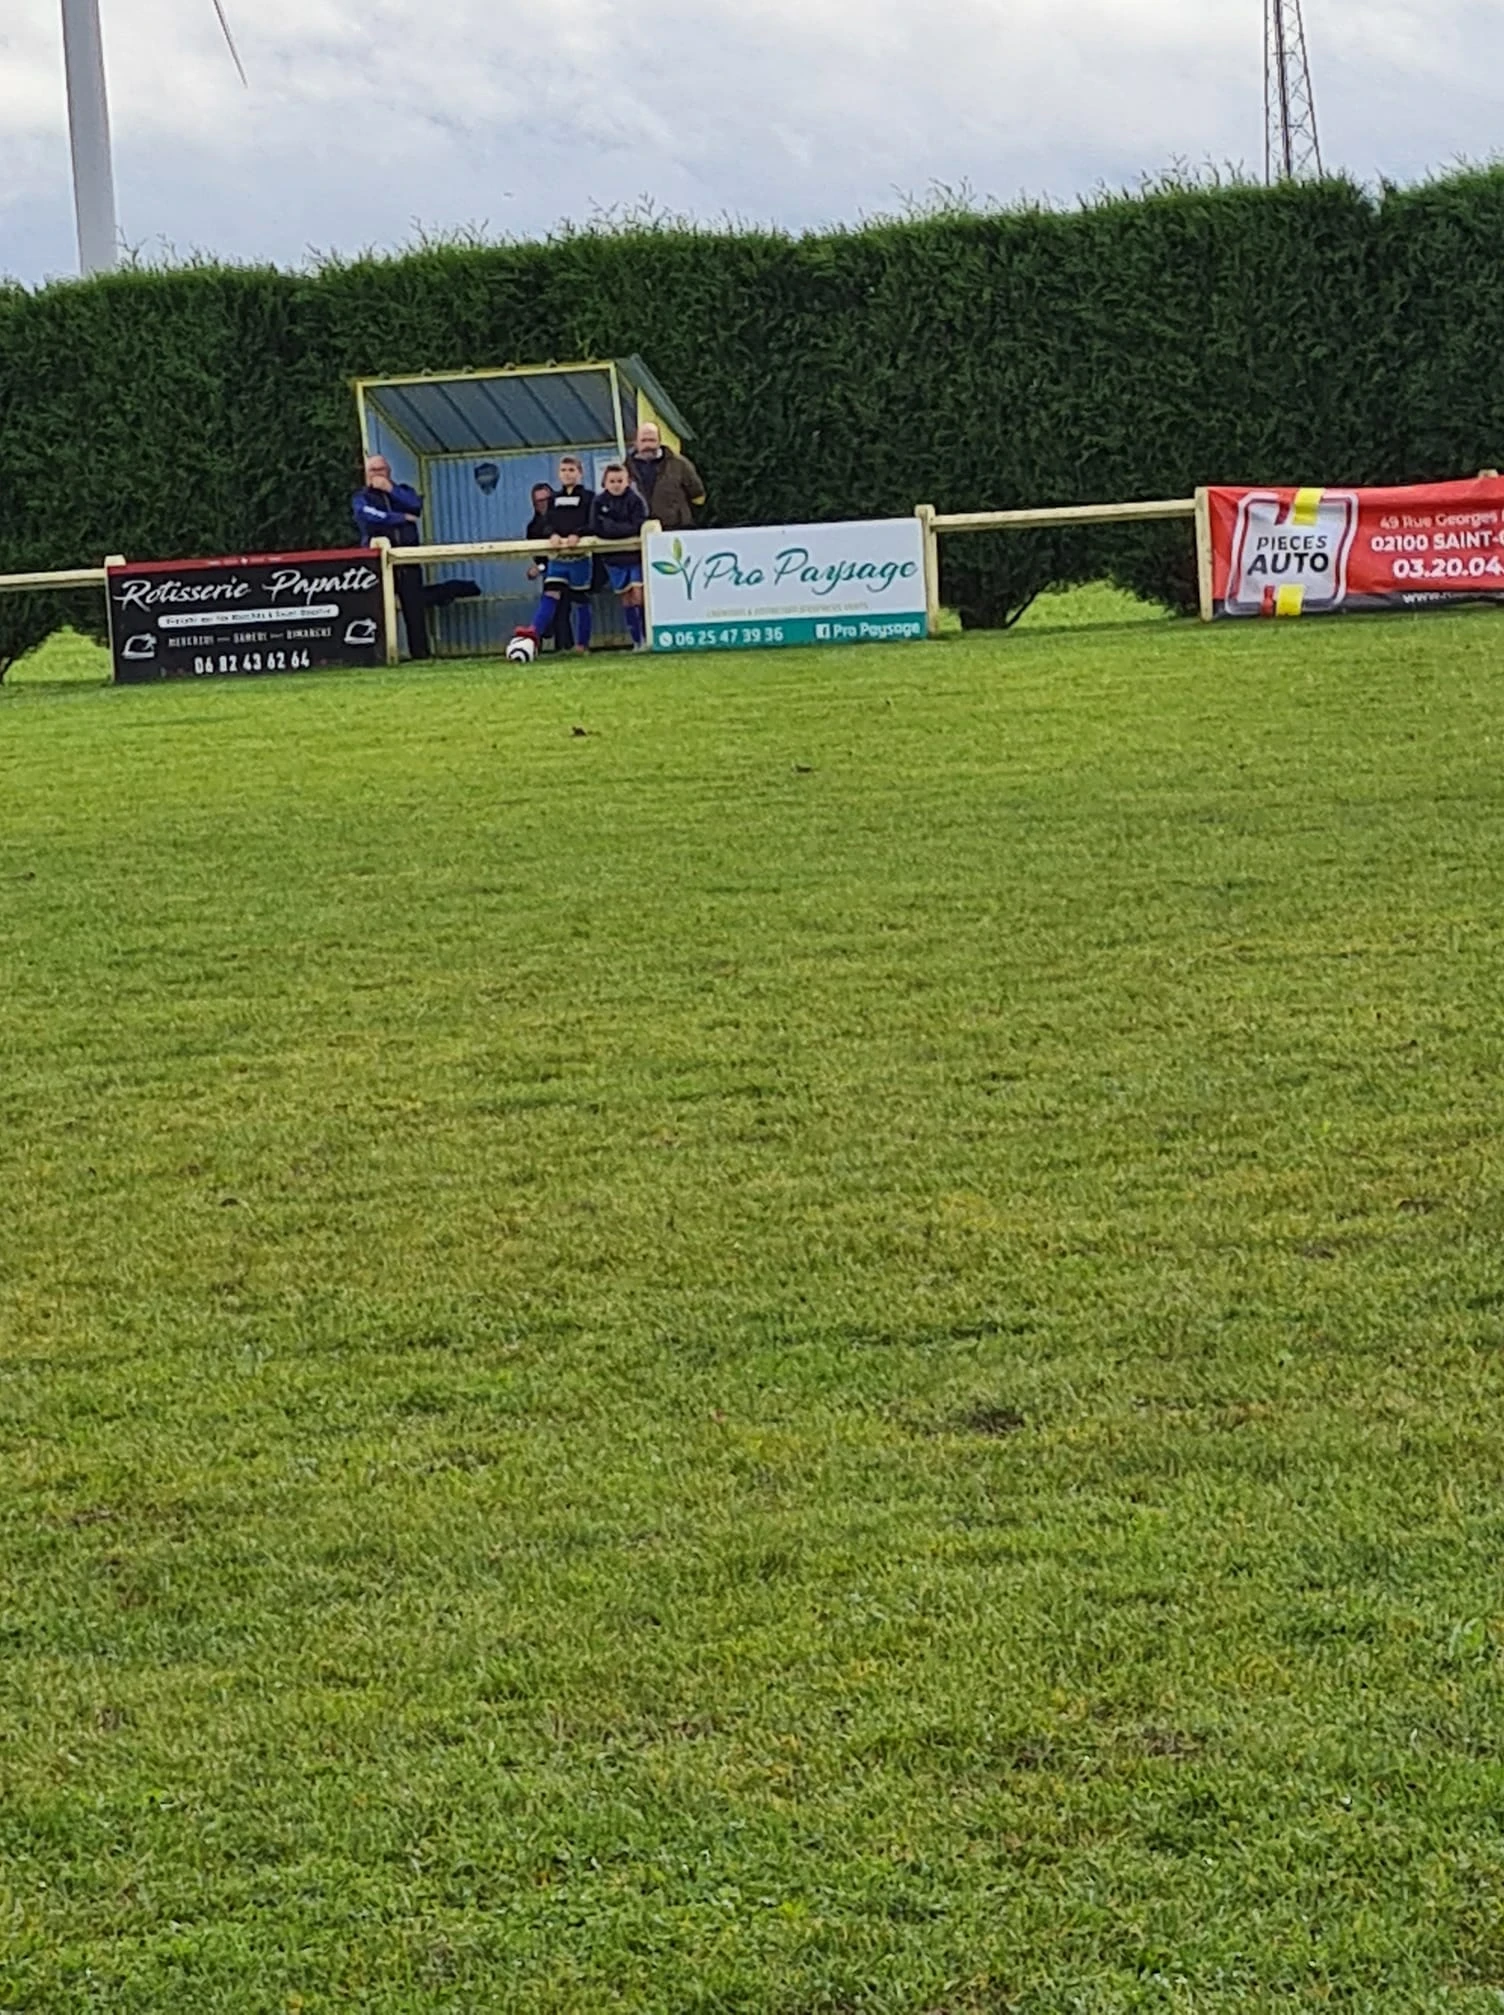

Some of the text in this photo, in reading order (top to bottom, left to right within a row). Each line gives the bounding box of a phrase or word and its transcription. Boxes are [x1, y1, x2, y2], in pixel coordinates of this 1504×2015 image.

[1380, 515, 1399, 530] 49
[1402, 513, 1432, 528] Rue
[1434, 508, 1498, 527] Georges
[1256, 534, 1328, 551] PIECES
[1371, 534, 1429, 552] 02100
[703, 547, 919, 596] Pro Paysage
[1247, 552, 1329, 576] AUTO
[113, 565, 379, 612] Rotisserie Papatte
[675, 626, 784, 646] 06 25 47 39 36
[833, 621, 921, 639] Pro Paysage
[194, 656, 214, 675] 06
[242, 652, 262, 671] 43
[267, 651, 286, 670] 62
[291, 648, 310, 668] 64
